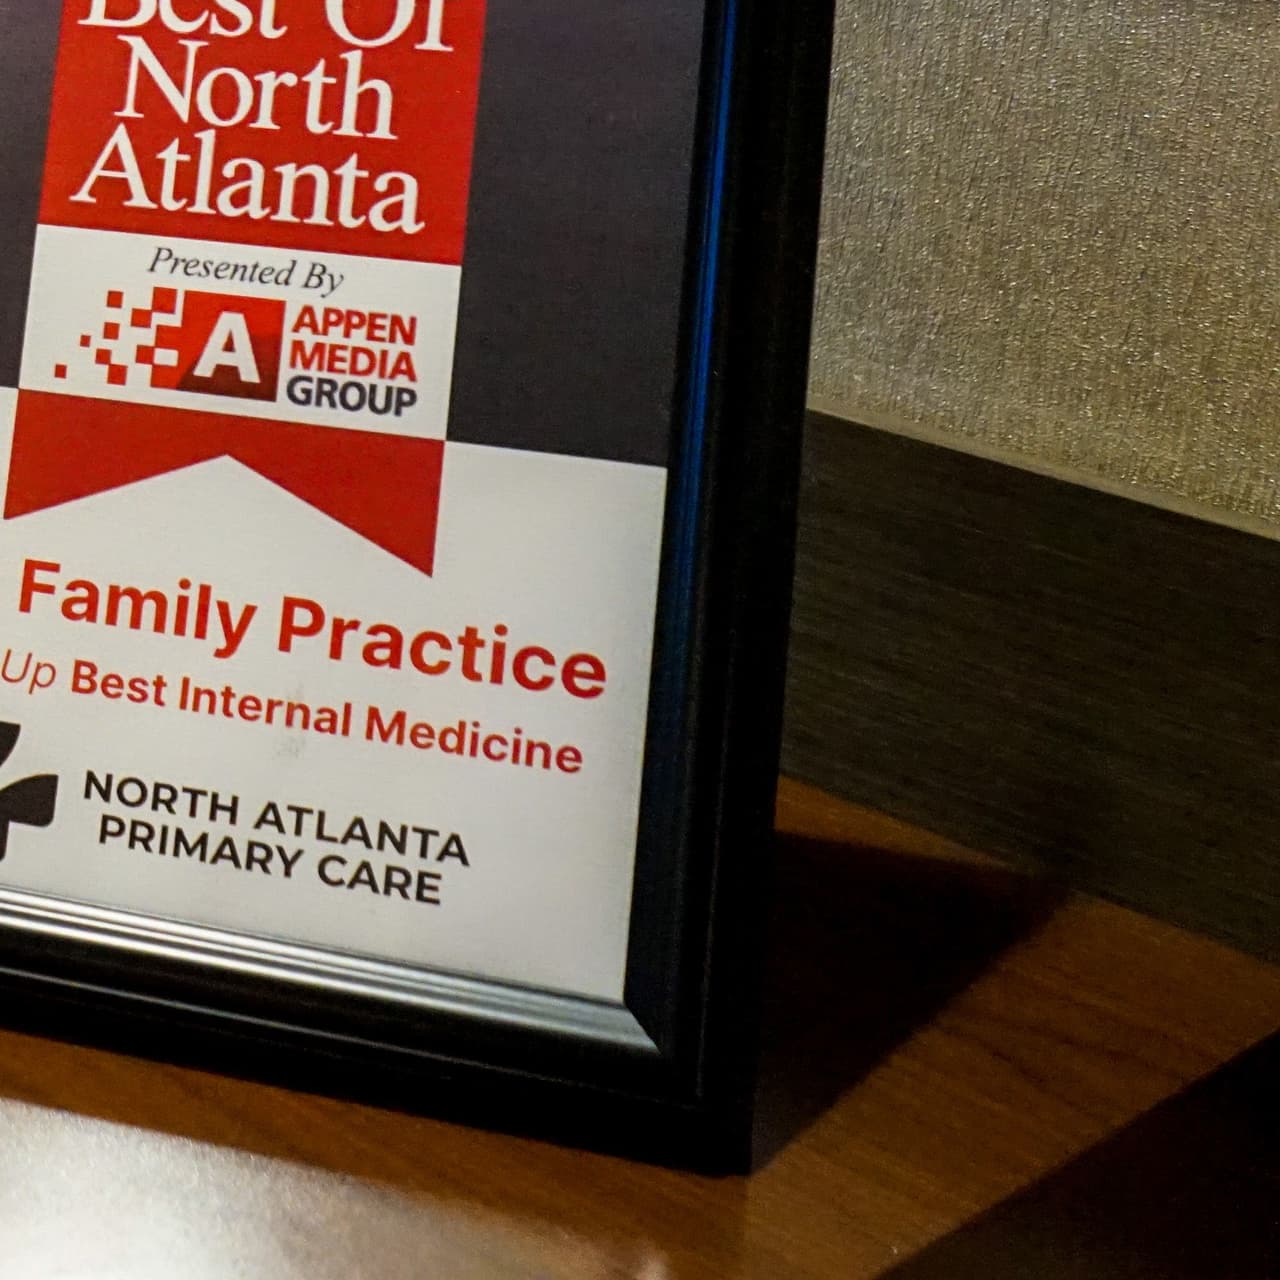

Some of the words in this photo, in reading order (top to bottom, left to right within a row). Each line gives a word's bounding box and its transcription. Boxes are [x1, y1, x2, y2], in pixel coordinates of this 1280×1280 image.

[113, 35, 398, 140] North
[69, 123, 425, 234] Atlanta
[148, 247, 295, 287] Presented
[303, 265, 345, 298] By
[192, 312, 260, 383] A
[291, 305, 417, 346] APPEN
[288, 339, 417, 382] MEDIA
[286, 375, 417, 417] GROUP
[18, 559, 257, 658] Family
[277, 596, 609, 700] Practice
[70, 660, 168, 707] Best
[179, 676, 353, 739] Internal
[365, 705, 585, 775] Medicine
[82, 770, 240, 826] NORTH
[252, 801, 471, 868] ATLANTA
[98, 814, 303, 878] PRIMARY
[316, 854, 443, 906] CARE
